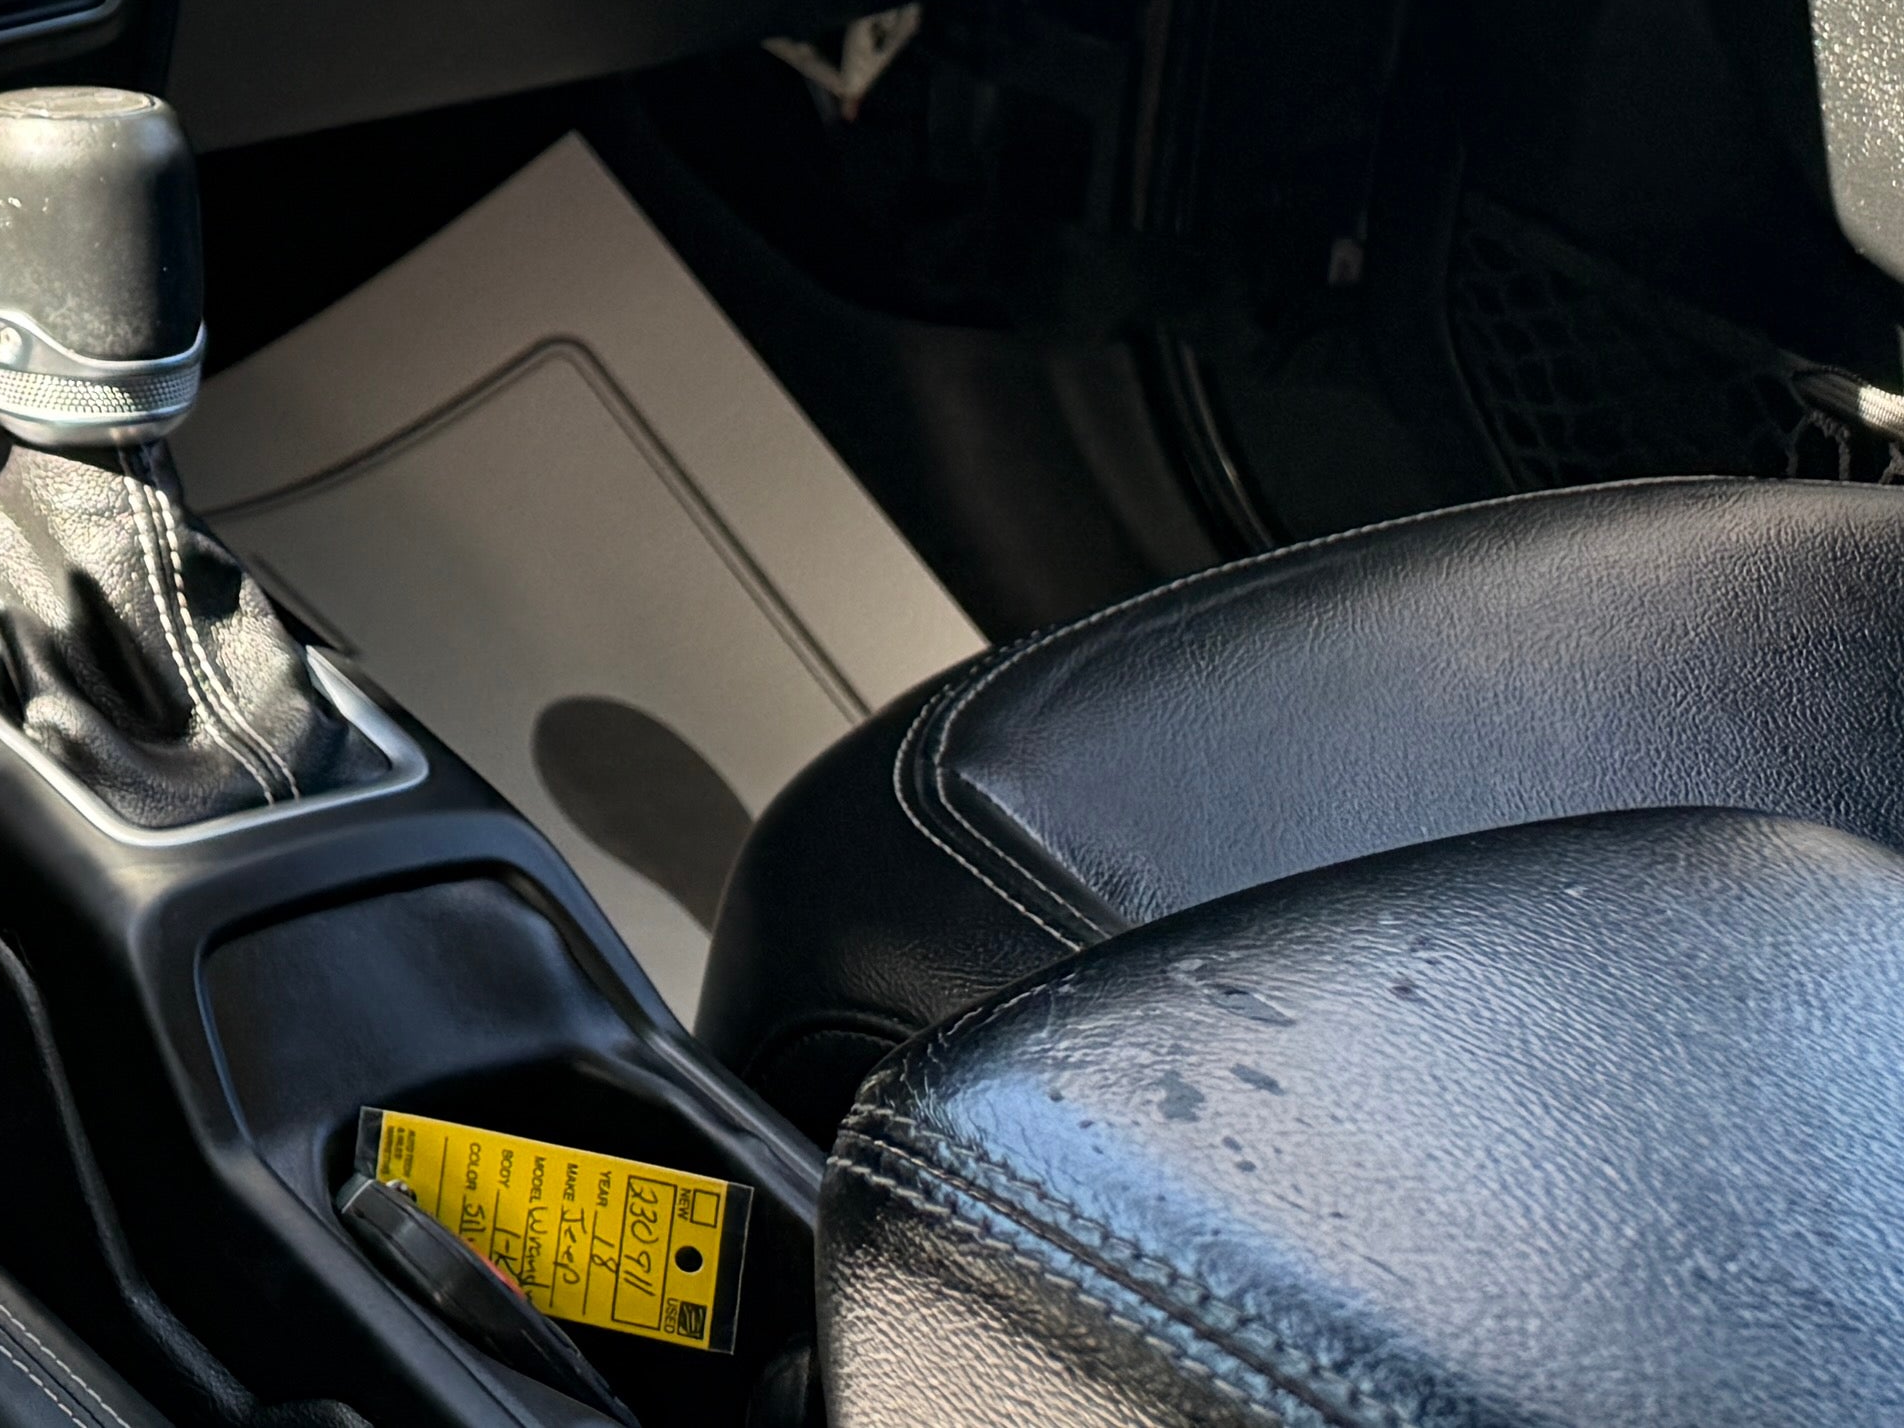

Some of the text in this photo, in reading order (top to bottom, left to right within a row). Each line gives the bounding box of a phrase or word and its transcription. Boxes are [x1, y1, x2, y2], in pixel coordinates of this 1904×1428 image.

[464, 1142, 482, 1192] COLOR
[498, 1150, 514, 1190] BODY
[527, 1156, 547, 1202] MODEL
[563, 1162, 579, 1202] MAKE
[597, 1171, 613, 1208] YEAR
[676, 1187, 692, 1221] NEW
[558, 1206, 587, 1286] Jeep
[591, 1232, 619, 1274] 18
[663, 1298, 679, 1335] USED
